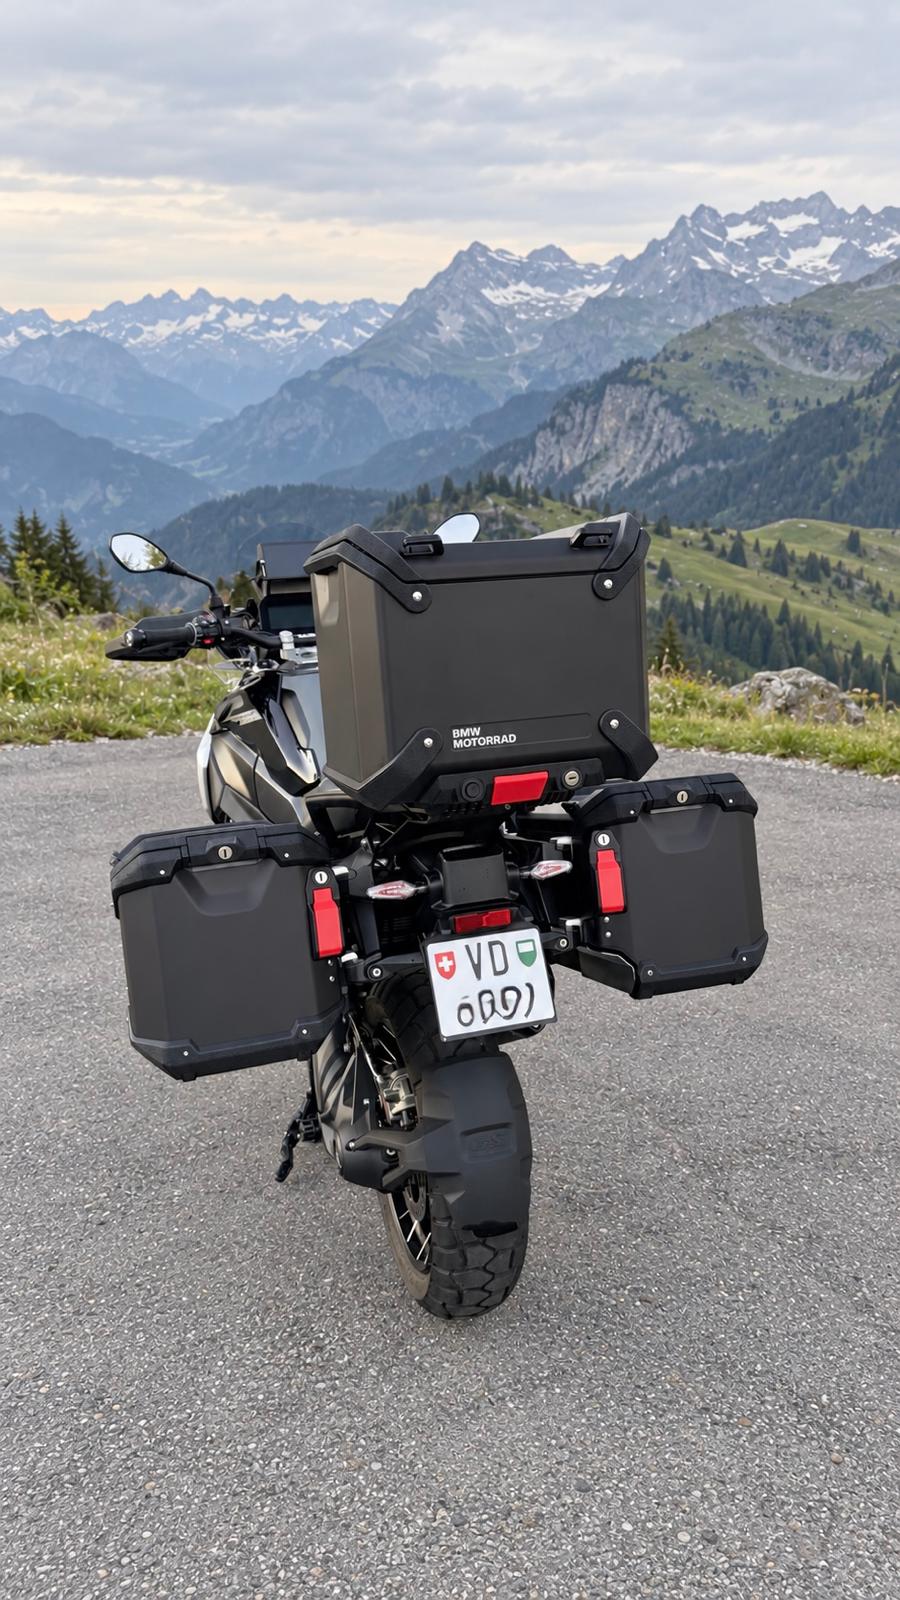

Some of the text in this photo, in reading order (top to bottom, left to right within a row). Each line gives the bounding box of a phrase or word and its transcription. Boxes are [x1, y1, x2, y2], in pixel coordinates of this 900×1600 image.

[452, 726, 481, 739] BMW
[453, 734, 517, 749] MOTORRAD
[465, 940, 509, 981] VD
